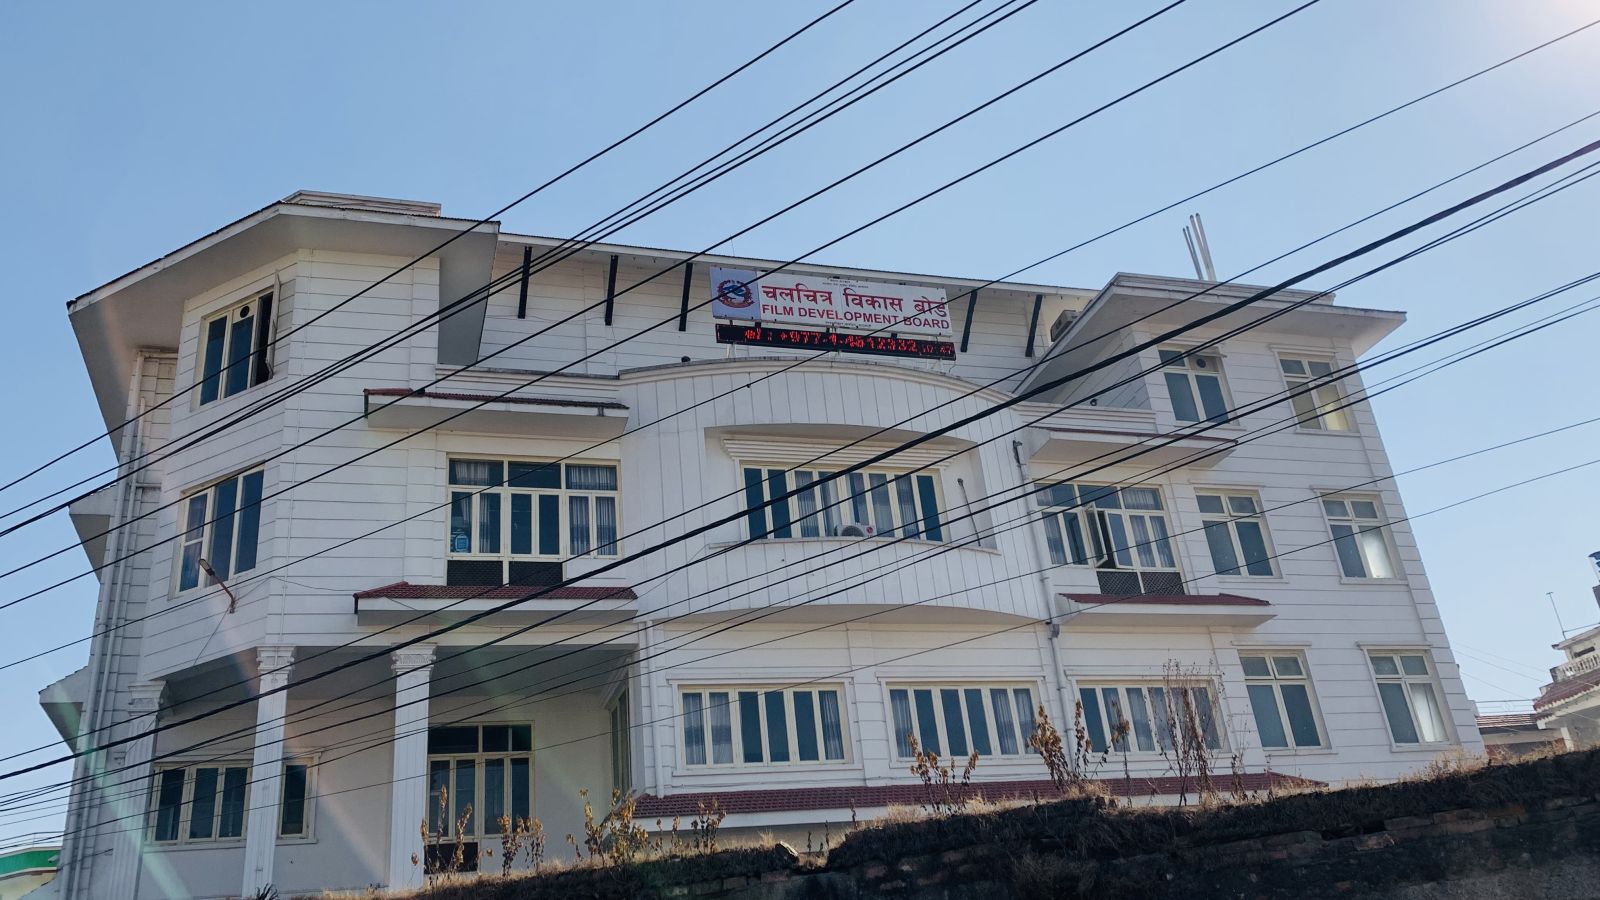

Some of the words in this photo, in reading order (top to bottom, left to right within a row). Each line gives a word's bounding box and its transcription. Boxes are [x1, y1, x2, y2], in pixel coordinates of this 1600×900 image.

[761, 283, 833, 305] चलचित्र
[843, 287, 904, 312] विकास
[762, 304, 794, 316] FILM
[798, 307, 899, 324] DEVELOPMENT
[903, 316, 950, 329] BOARD
